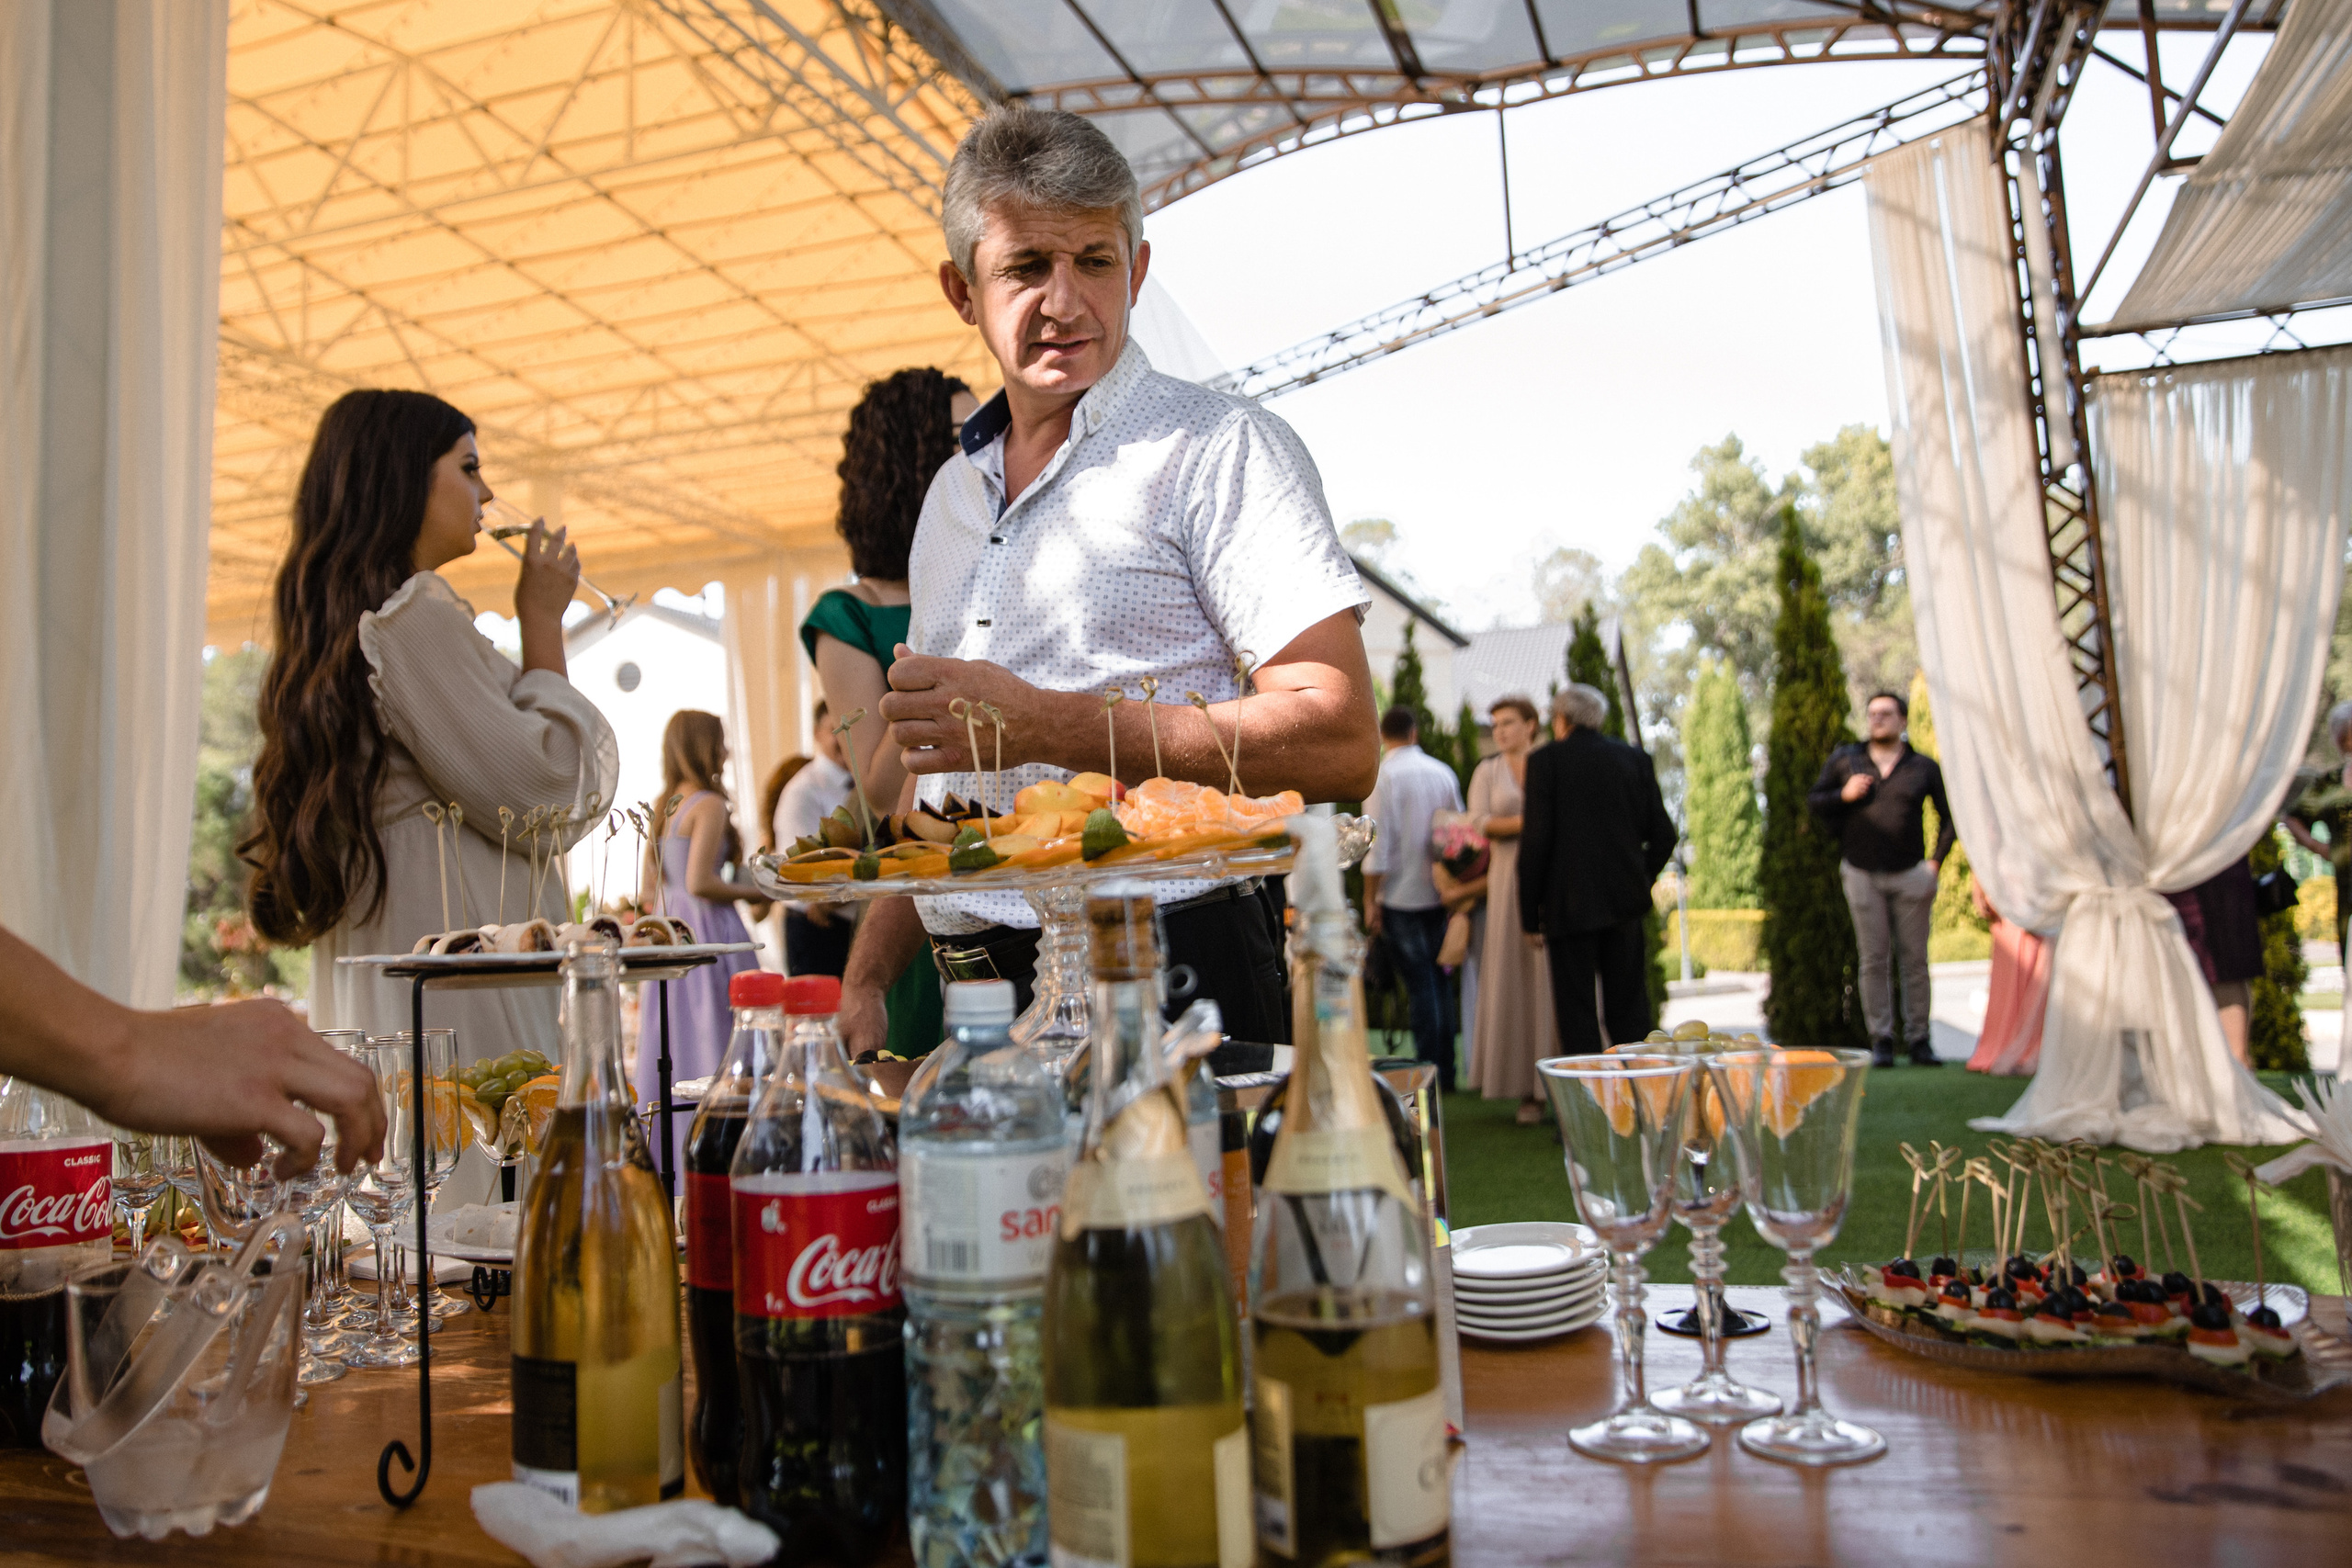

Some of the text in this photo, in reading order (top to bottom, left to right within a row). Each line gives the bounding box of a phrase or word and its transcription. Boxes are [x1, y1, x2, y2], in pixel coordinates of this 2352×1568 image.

[63, 1155, 101, 1168] CLASSIC
[0, 1175, 112, 1239] Coca-Col
[1000, 1204, 1063, 1243] san
